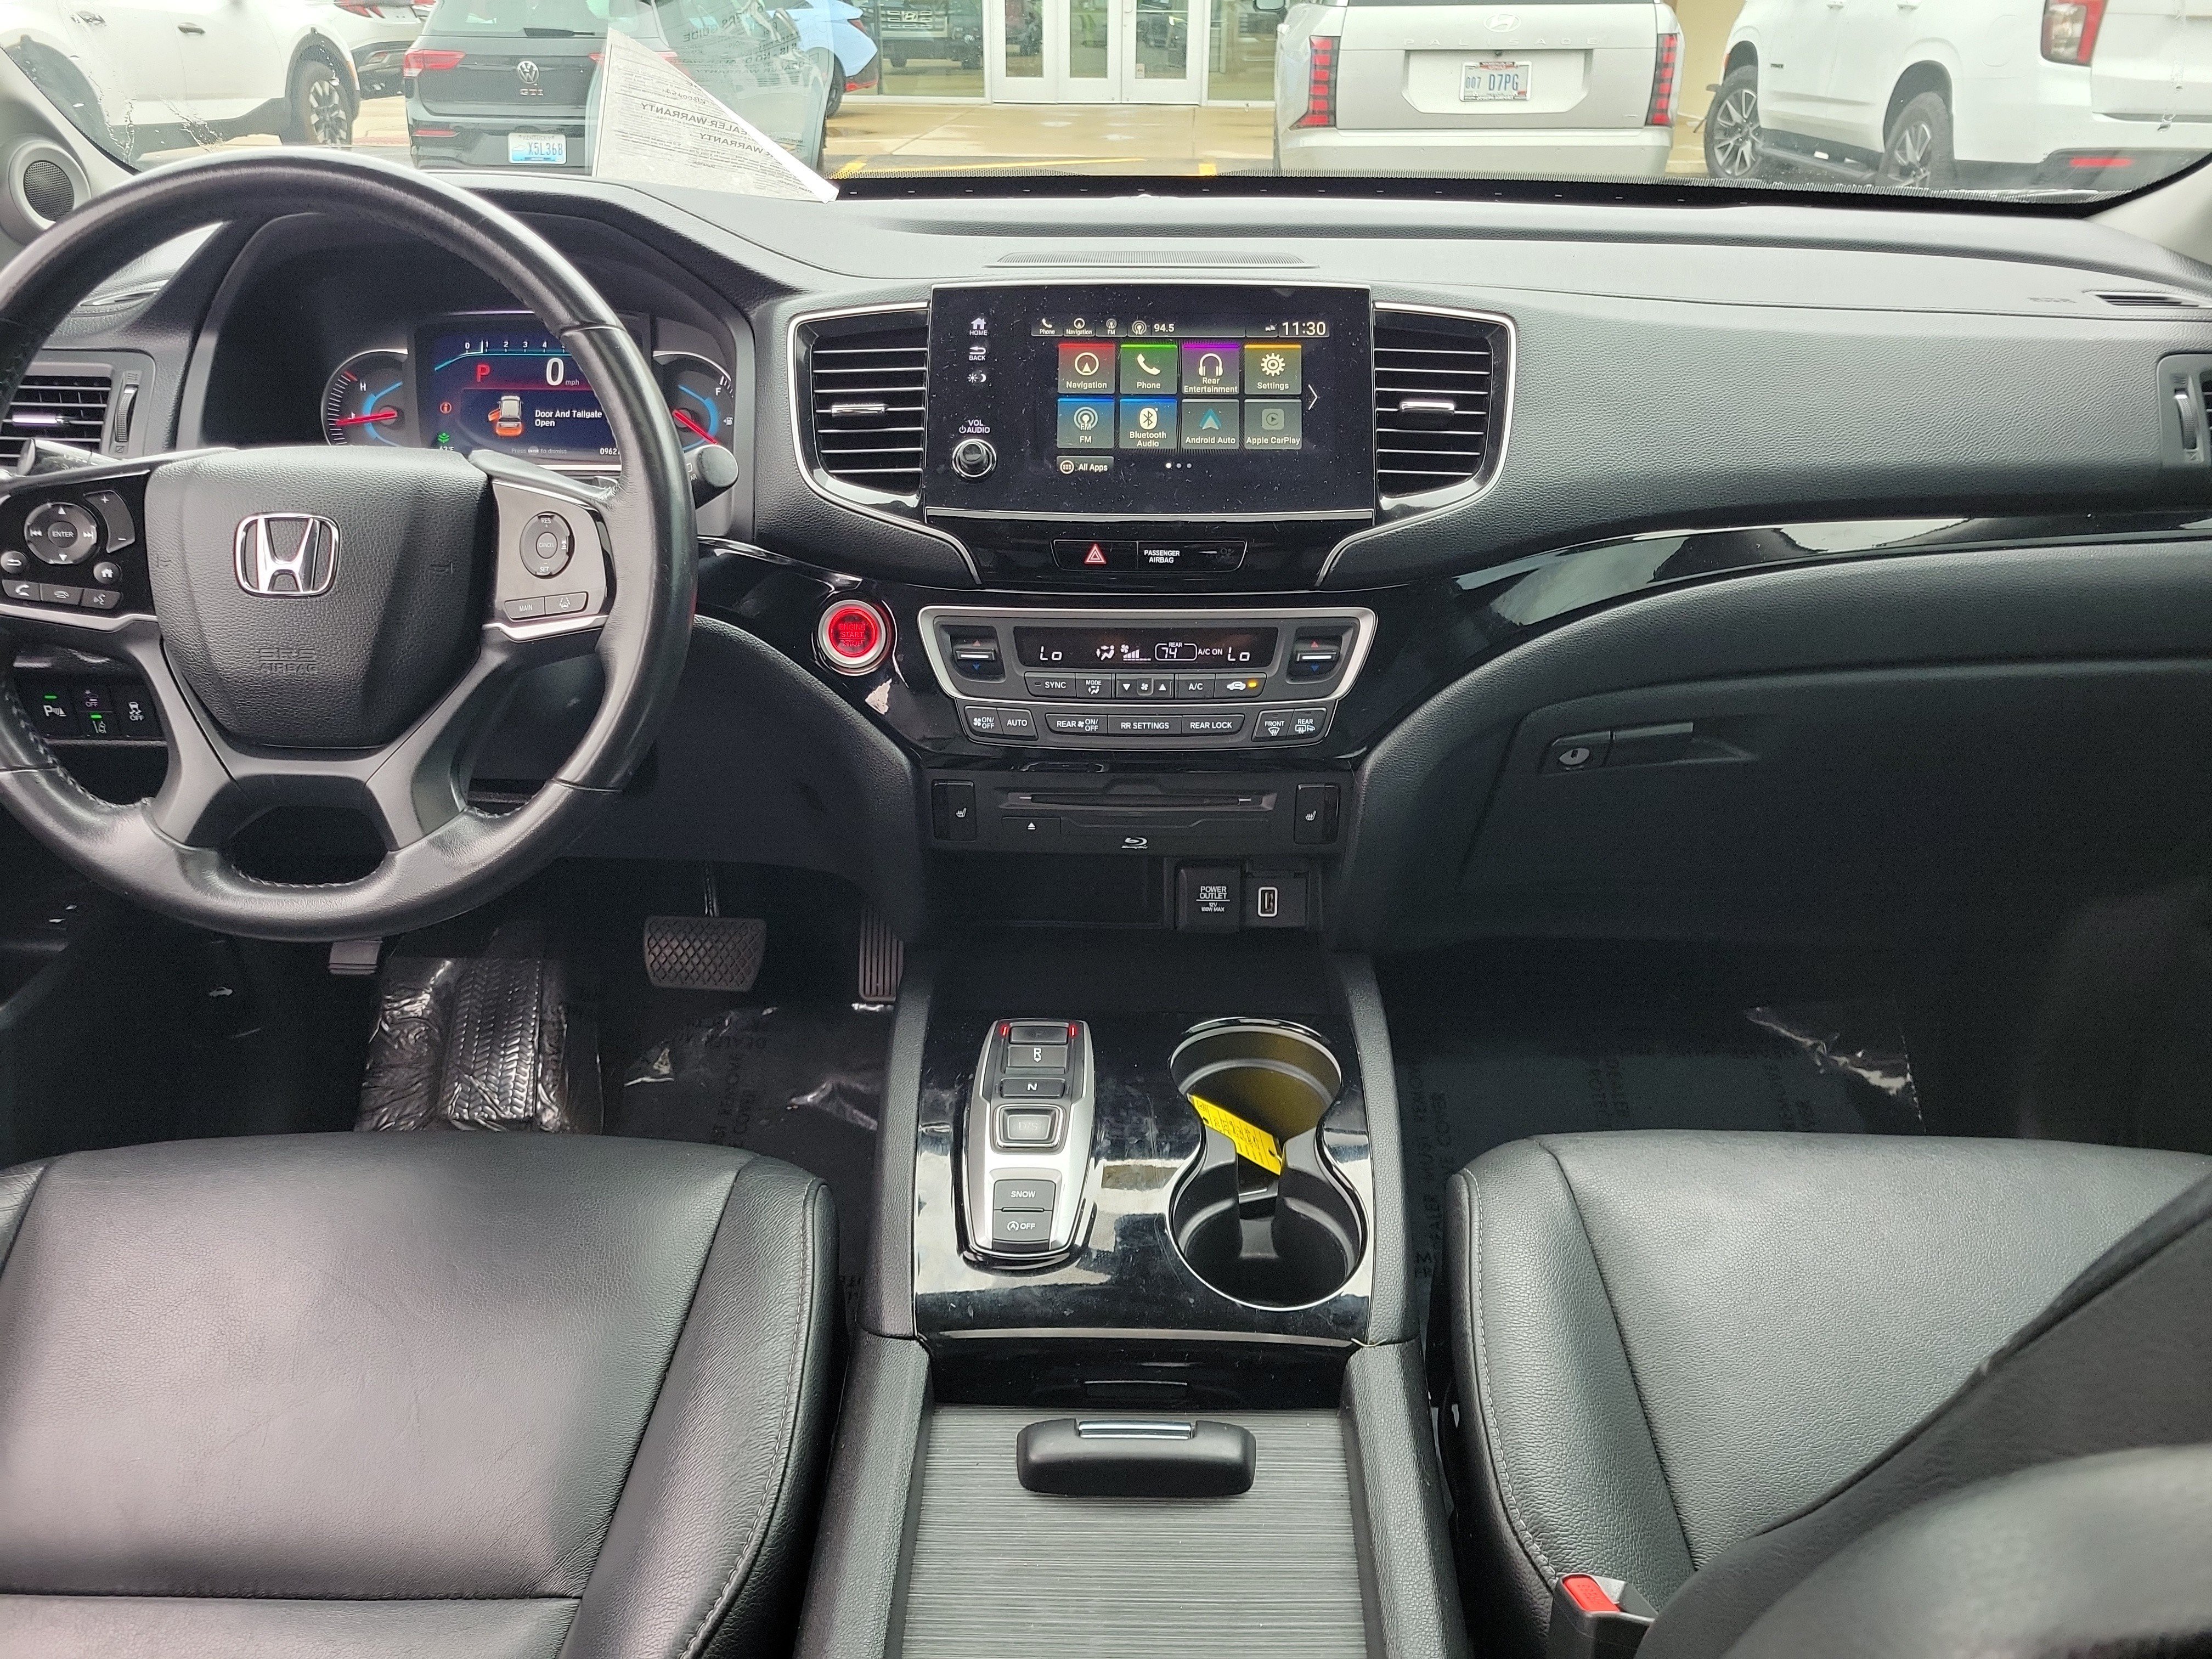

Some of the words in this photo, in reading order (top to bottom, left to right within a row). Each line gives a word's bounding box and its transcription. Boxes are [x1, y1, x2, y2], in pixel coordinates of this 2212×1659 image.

[1403, 37, 1598, 46] PALISADE
[1465, 77, 1481, 89] 007
[1488, 74, 1519, 91] D7PG
[528, 142, 563, 156] X5L368
[1154, 323, 1175, 332] 94.5
[1282, 321, 1327, 336] 11:30
[476, 364, 490, 382] P
[546, 358, 564, 386] 0
[360, 381, 366, 391] H
[1066, 381, 1107, 390] Navigation
[1257, 382, 1289, 391] Settings
[715, 387, 721, 396] F
[535, 410, 554, 418] Door
[555, 410, 570, 418] And
[572, 410, 602, 420] Tailgate
[535, 419, 555, 427] Open
[1246, 436, 1269, 445] Apple
[1271, 436, 1300, 445] CarPlay
[1078, 463, 1089, 471] All
[1090, 464, 1108, 473] Apps
[1161, 647, 1178, 659] 74
[1188, 682, 1203, 691] A/C
[1057, 720, 1076, 728] REAR
[1033, 1047, 1042, 1058] R
[1027, 1082, 1037, 1091] N
